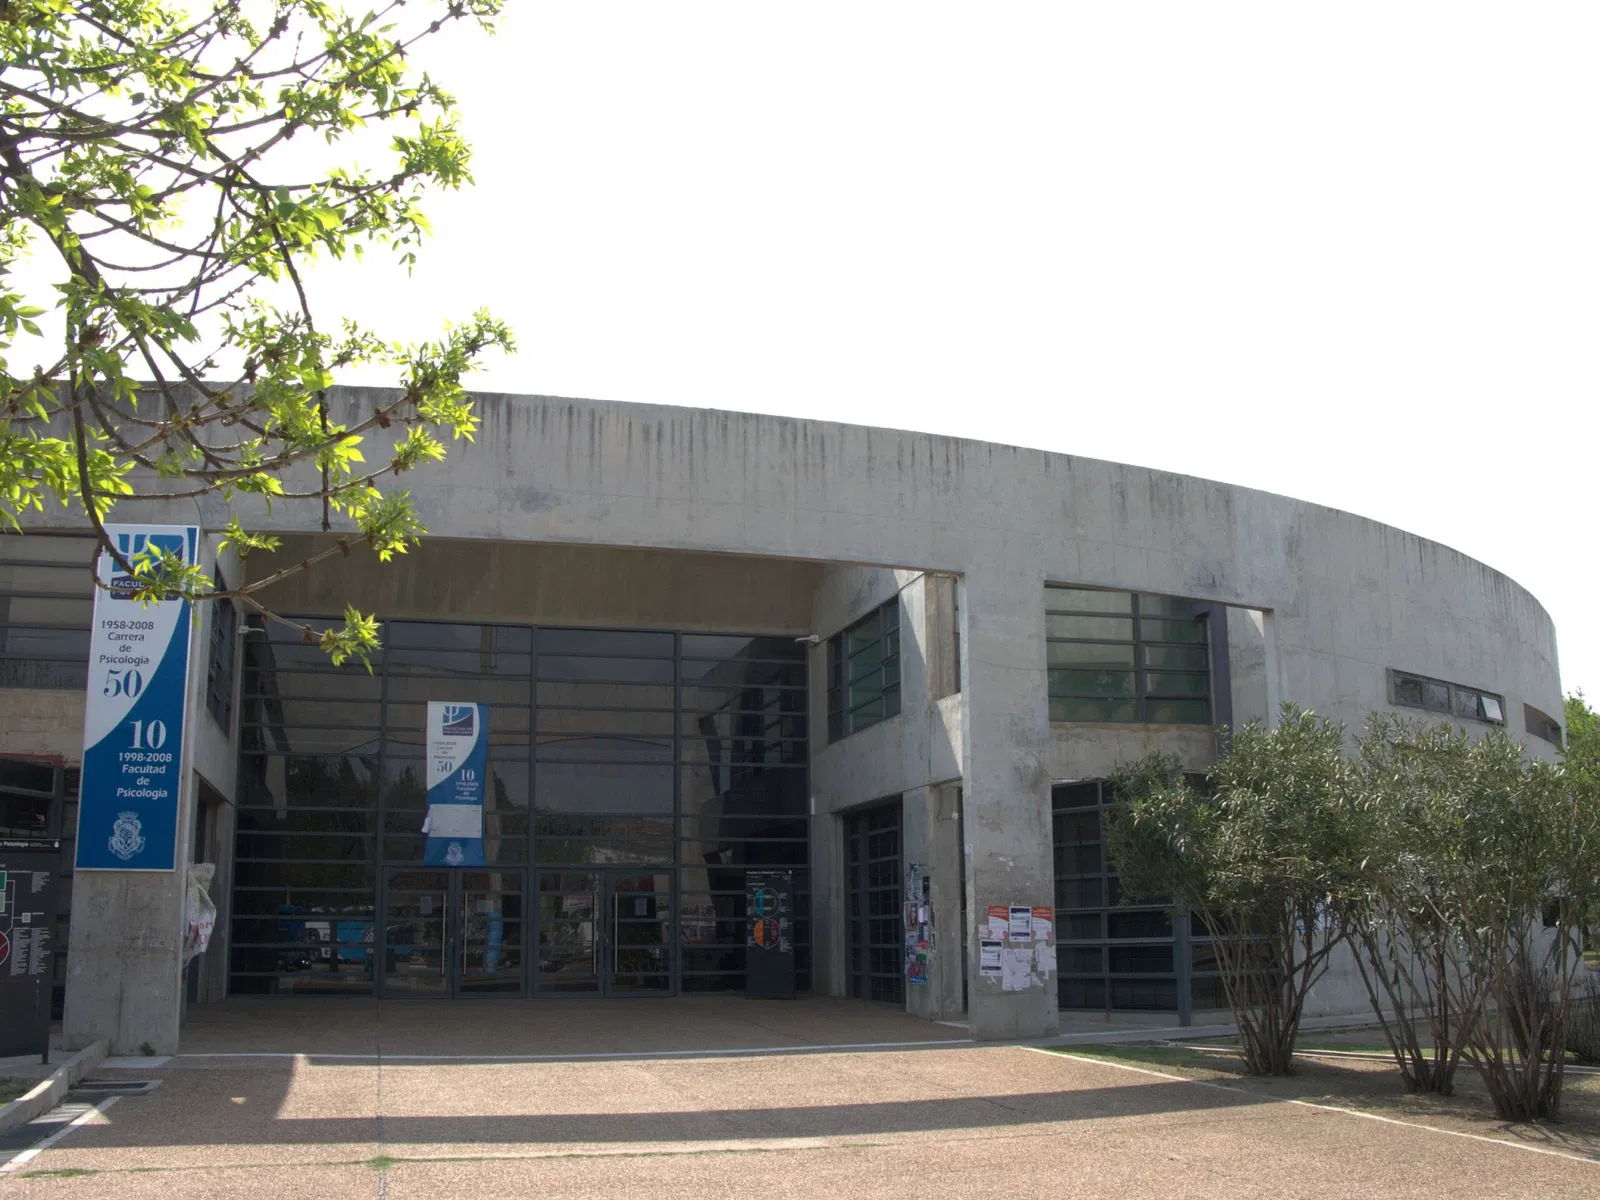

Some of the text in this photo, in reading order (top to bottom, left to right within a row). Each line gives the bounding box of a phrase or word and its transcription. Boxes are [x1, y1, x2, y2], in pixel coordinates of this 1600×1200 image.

[101, 620, 155, 630] 1958-2008
[107, 632, 145, 641] Carrera
[119, 643, 132, 653] de
[103, 668, 143, 698] 50
[128, 719, 168, 750] 10
[118, 752, 173, 762] 1998-2008
[122, 764, 167, 774] Facultad
[436, 760, 453, 773] 50
[460, 768, 476, 781] 10
[136, 776, 150, 786] de
